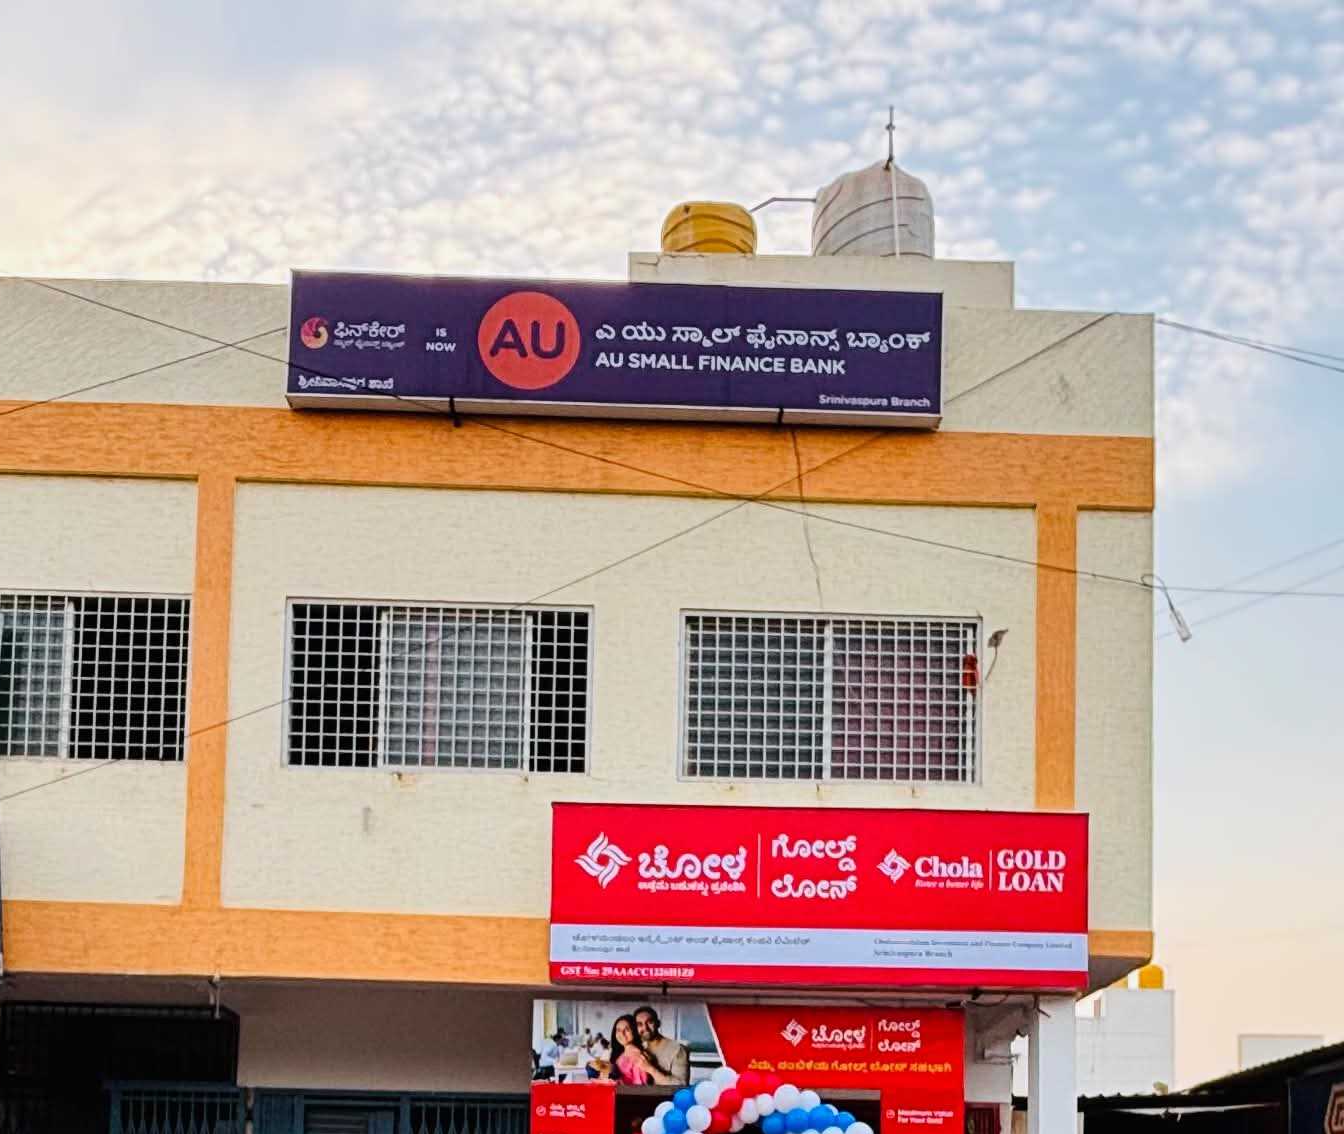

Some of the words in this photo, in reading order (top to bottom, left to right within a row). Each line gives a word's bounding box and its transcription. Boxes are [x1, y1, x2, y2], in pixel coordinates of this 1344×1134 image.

[436, 327, 446, 337] IS
[489, 318, 565, 359] AU
[595, 323, 615, 340] ಎ
[622, 322, 666, 341] ಯು
[426, 341, 456, 352] NOW
[595, 352, 624, 368] AU
[627, 353, 694, 370] SMALL
[698, 356, 785, 373] FINANCE
[790, 358, 846, 375] BANK
[819, 394, 888, 407] Srinivaspura
[891, 395, 931, 408] Branch
[771, 833, 856, 872] ಗೋಲ್ಡ್
[997, 850, 1066, 870] GOLD
[914, 856, 984, 879] Chola
[771, 875, 856, 900] ಲೋನ್
[998, 872, 1064, 892] LOAN
[560, 965, 581, 976] GST
